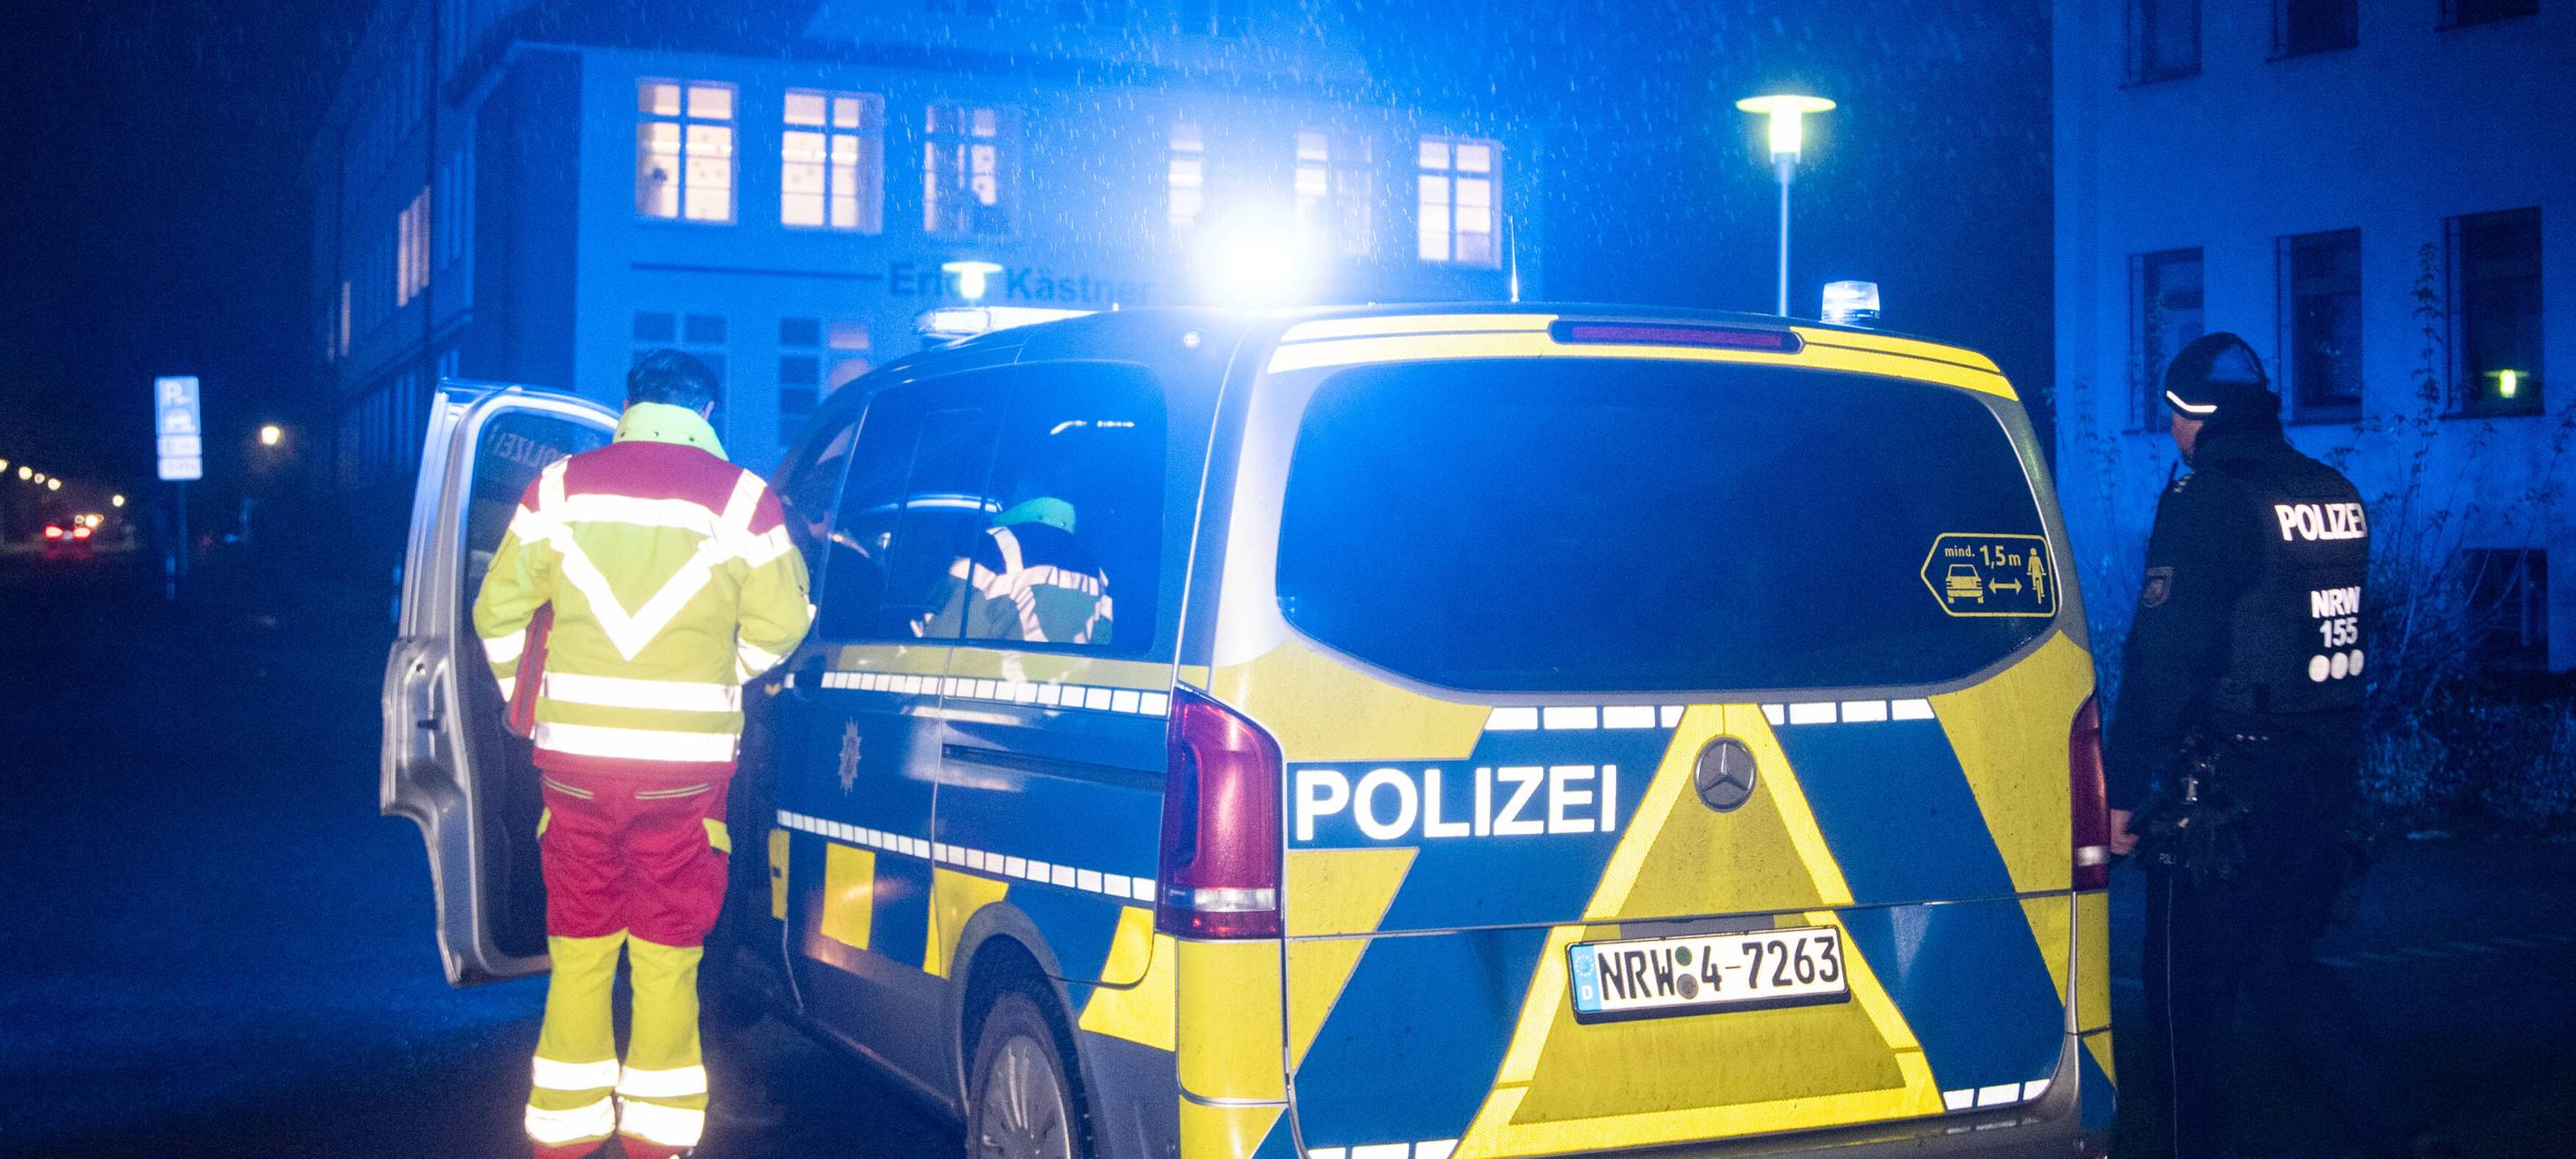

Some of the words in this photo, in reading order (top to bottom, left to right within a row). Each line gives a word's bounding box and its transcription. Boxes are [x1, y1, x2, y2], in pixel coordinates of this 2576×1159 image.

[890, 263, 964, 299] Eric
[1945, 545, 1975, 558] mind.
[1980, 545, 2006, 569] 1,5
[2009, 553, 2022, 566] m
[2311, 587, 2360, 618] NRW
[2320, 618, 2359, 647] 155
[1296, 764, 1617, 840] POLIZEI
[1581, 984, 1593, 1001] D
